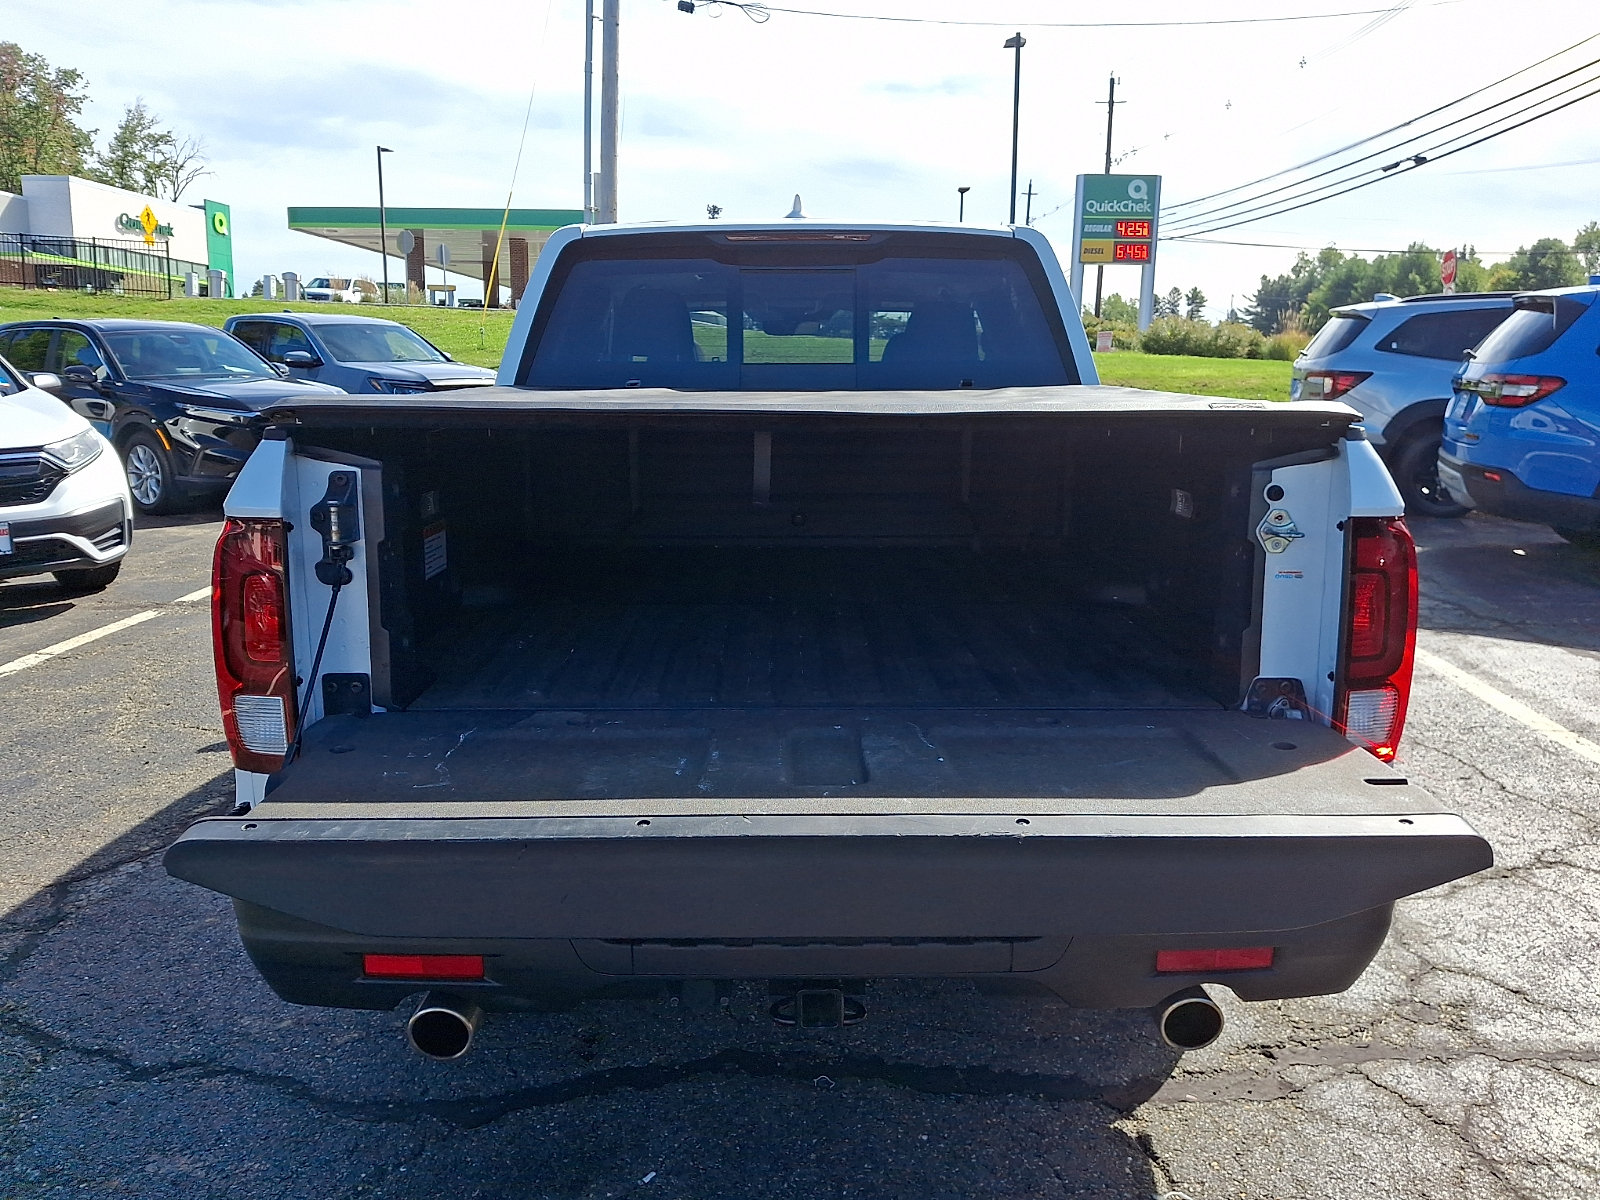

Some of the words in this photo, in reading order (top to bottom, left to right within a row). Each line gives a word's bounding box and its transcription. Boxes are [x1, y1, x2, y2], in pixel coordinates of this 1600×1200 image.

[1086, 200, 1152, 213] QuickChek
[1083, 224, 1113, 233] REGULAR
[1083, 247, 1105, 255] DIESEL
